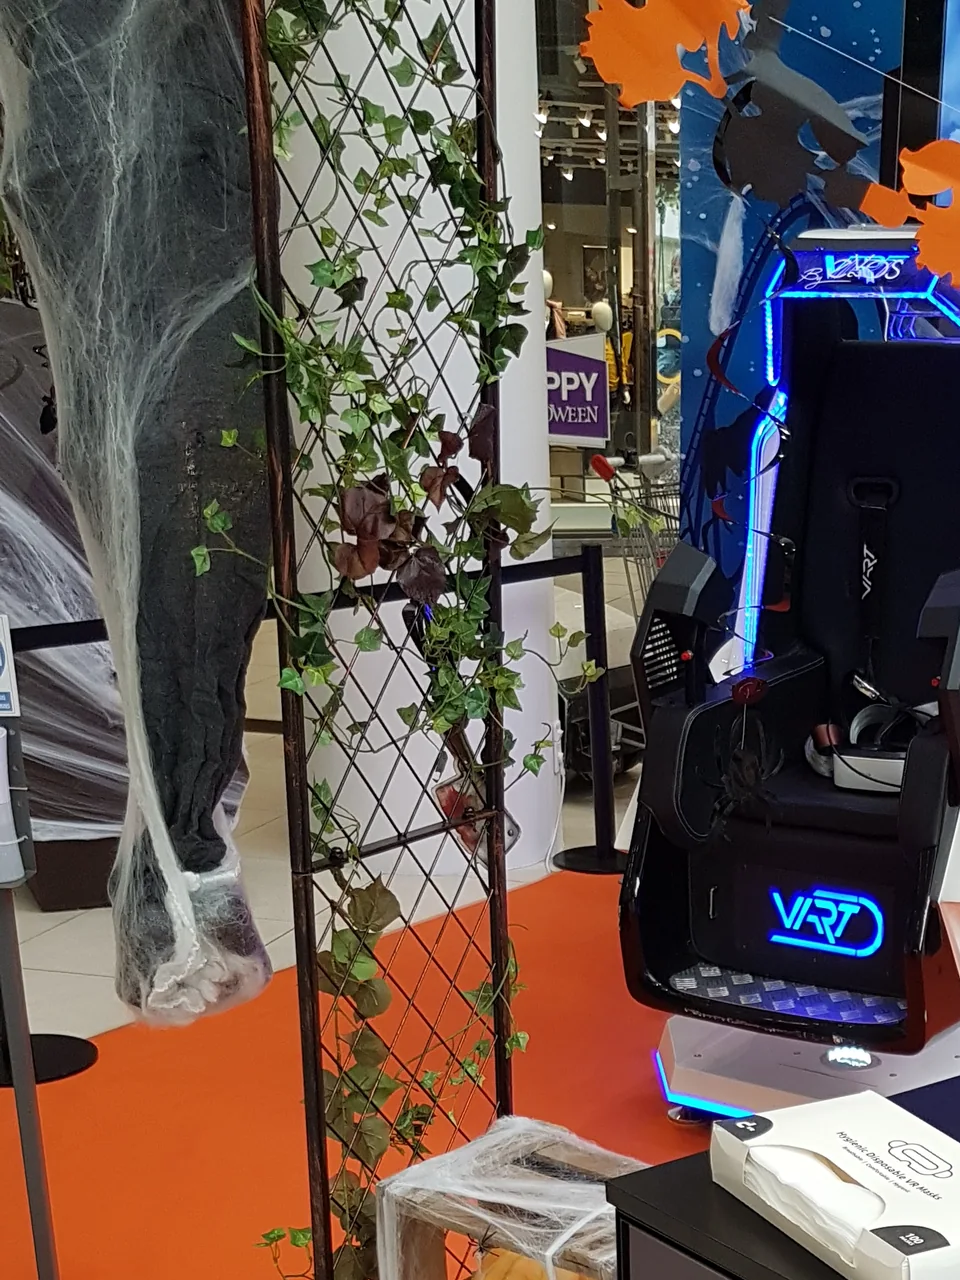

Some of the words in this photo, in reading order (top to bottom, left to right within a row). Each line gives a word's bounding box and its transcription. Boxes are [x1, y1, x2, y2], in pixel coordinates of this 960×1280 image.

[861, 542, 878, 600] VART
[772, 892, 861, 945] VART
[866, 1152, 907, 1180] Disposable
[905, 1178, 920, 1188] VR
[916, 1186, 943, 1201] Masks
[905, 1233, 924, 1244] 100
